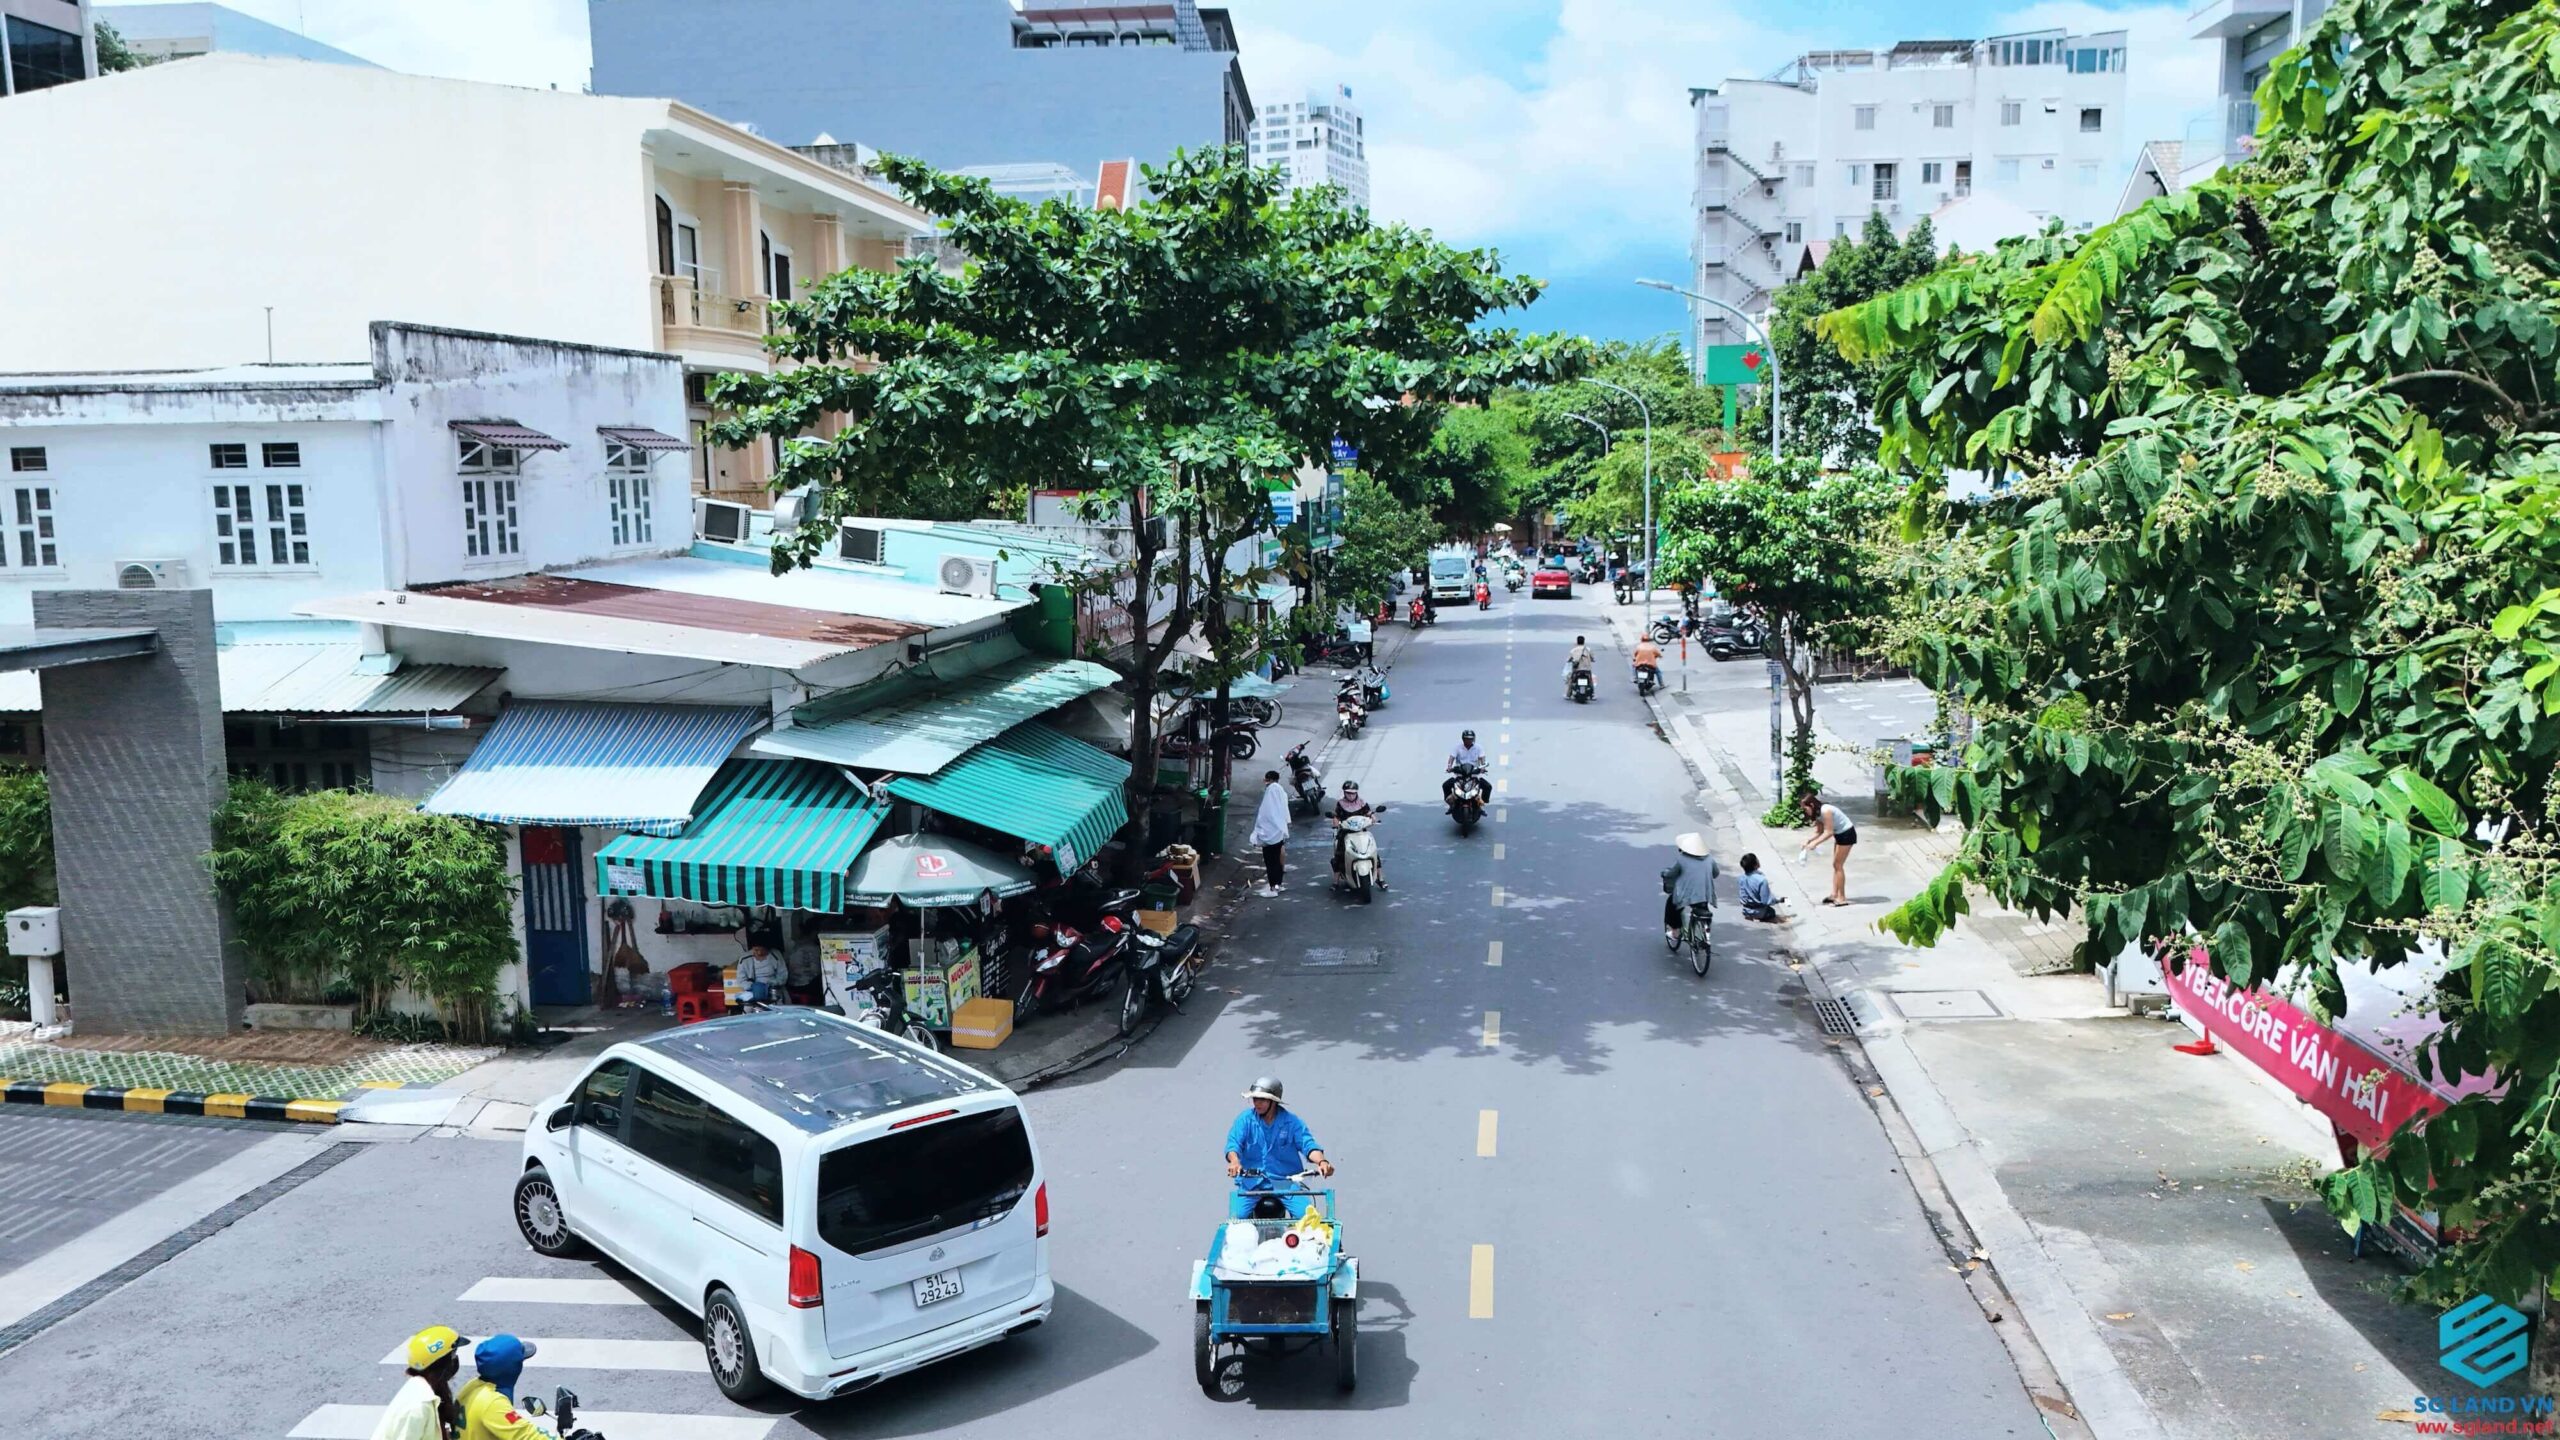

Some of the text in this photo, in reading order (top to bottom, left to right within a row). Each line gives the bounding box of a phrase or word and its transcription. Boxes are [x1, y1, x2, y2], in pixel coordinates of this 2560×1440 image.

[2176, 959, 2288, 1055] YBERCORE
[2290, 1030, 2339, 1089] VÂN
[926, 1273, 948, 1289] 51L
[920, 1283, 959, 1304] 292.43
[426, 1340, 445, 1354] be
